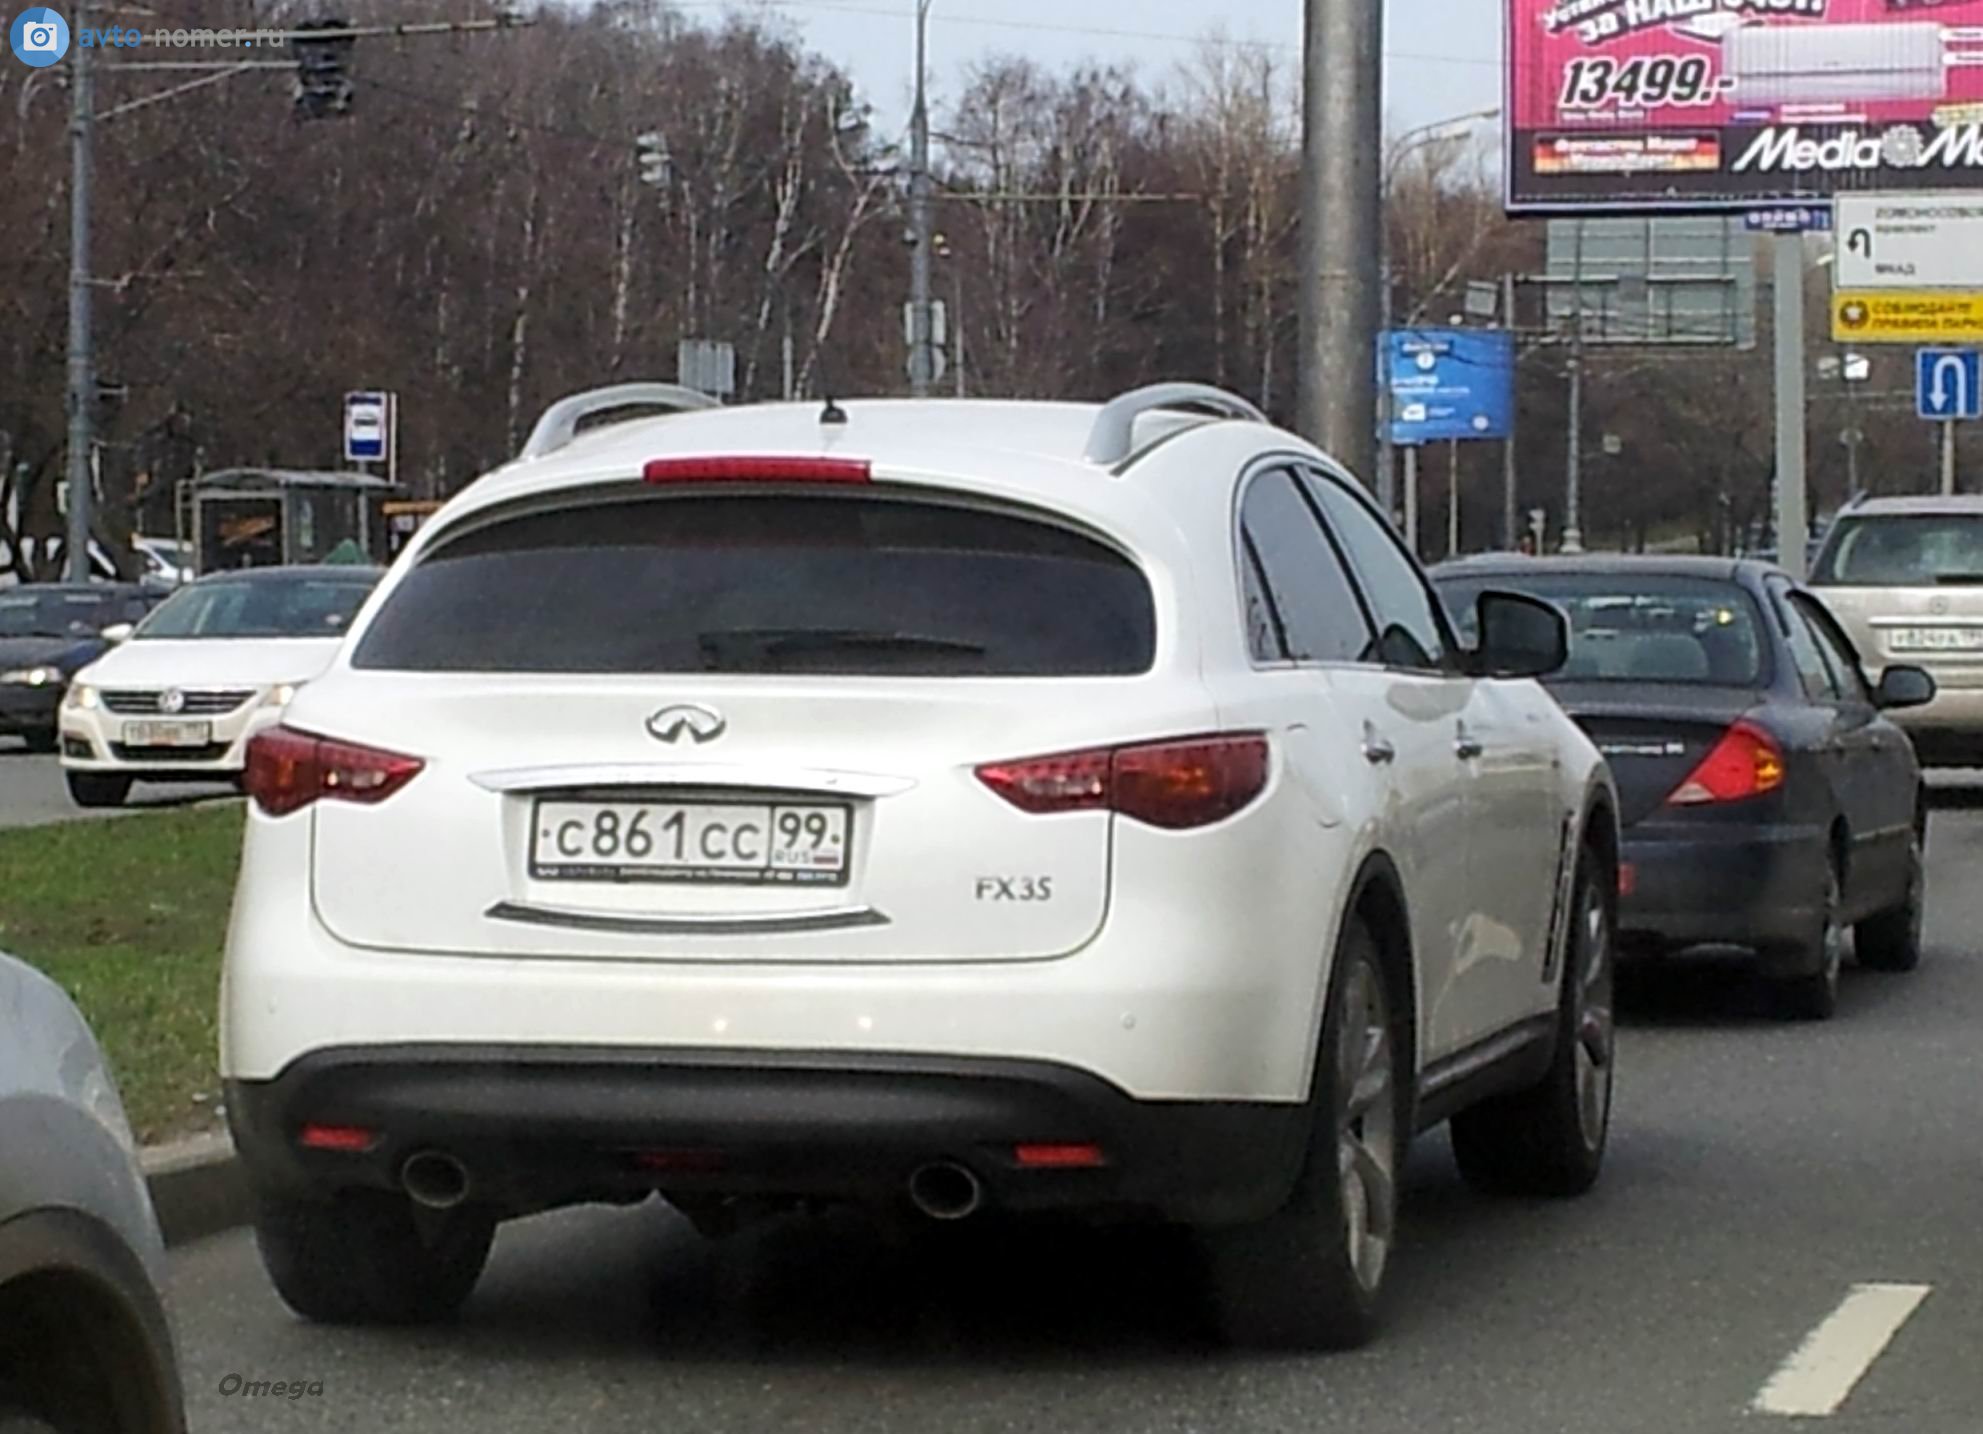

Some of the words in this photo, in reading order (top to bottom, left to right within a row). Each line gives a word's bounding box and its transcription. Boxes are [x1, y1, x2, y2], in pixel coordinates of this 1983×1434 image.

[1732, 127, 1881, 171] Media
[778, 811, 828, 850] 99
[976, 877, 1051, 900] FX35
